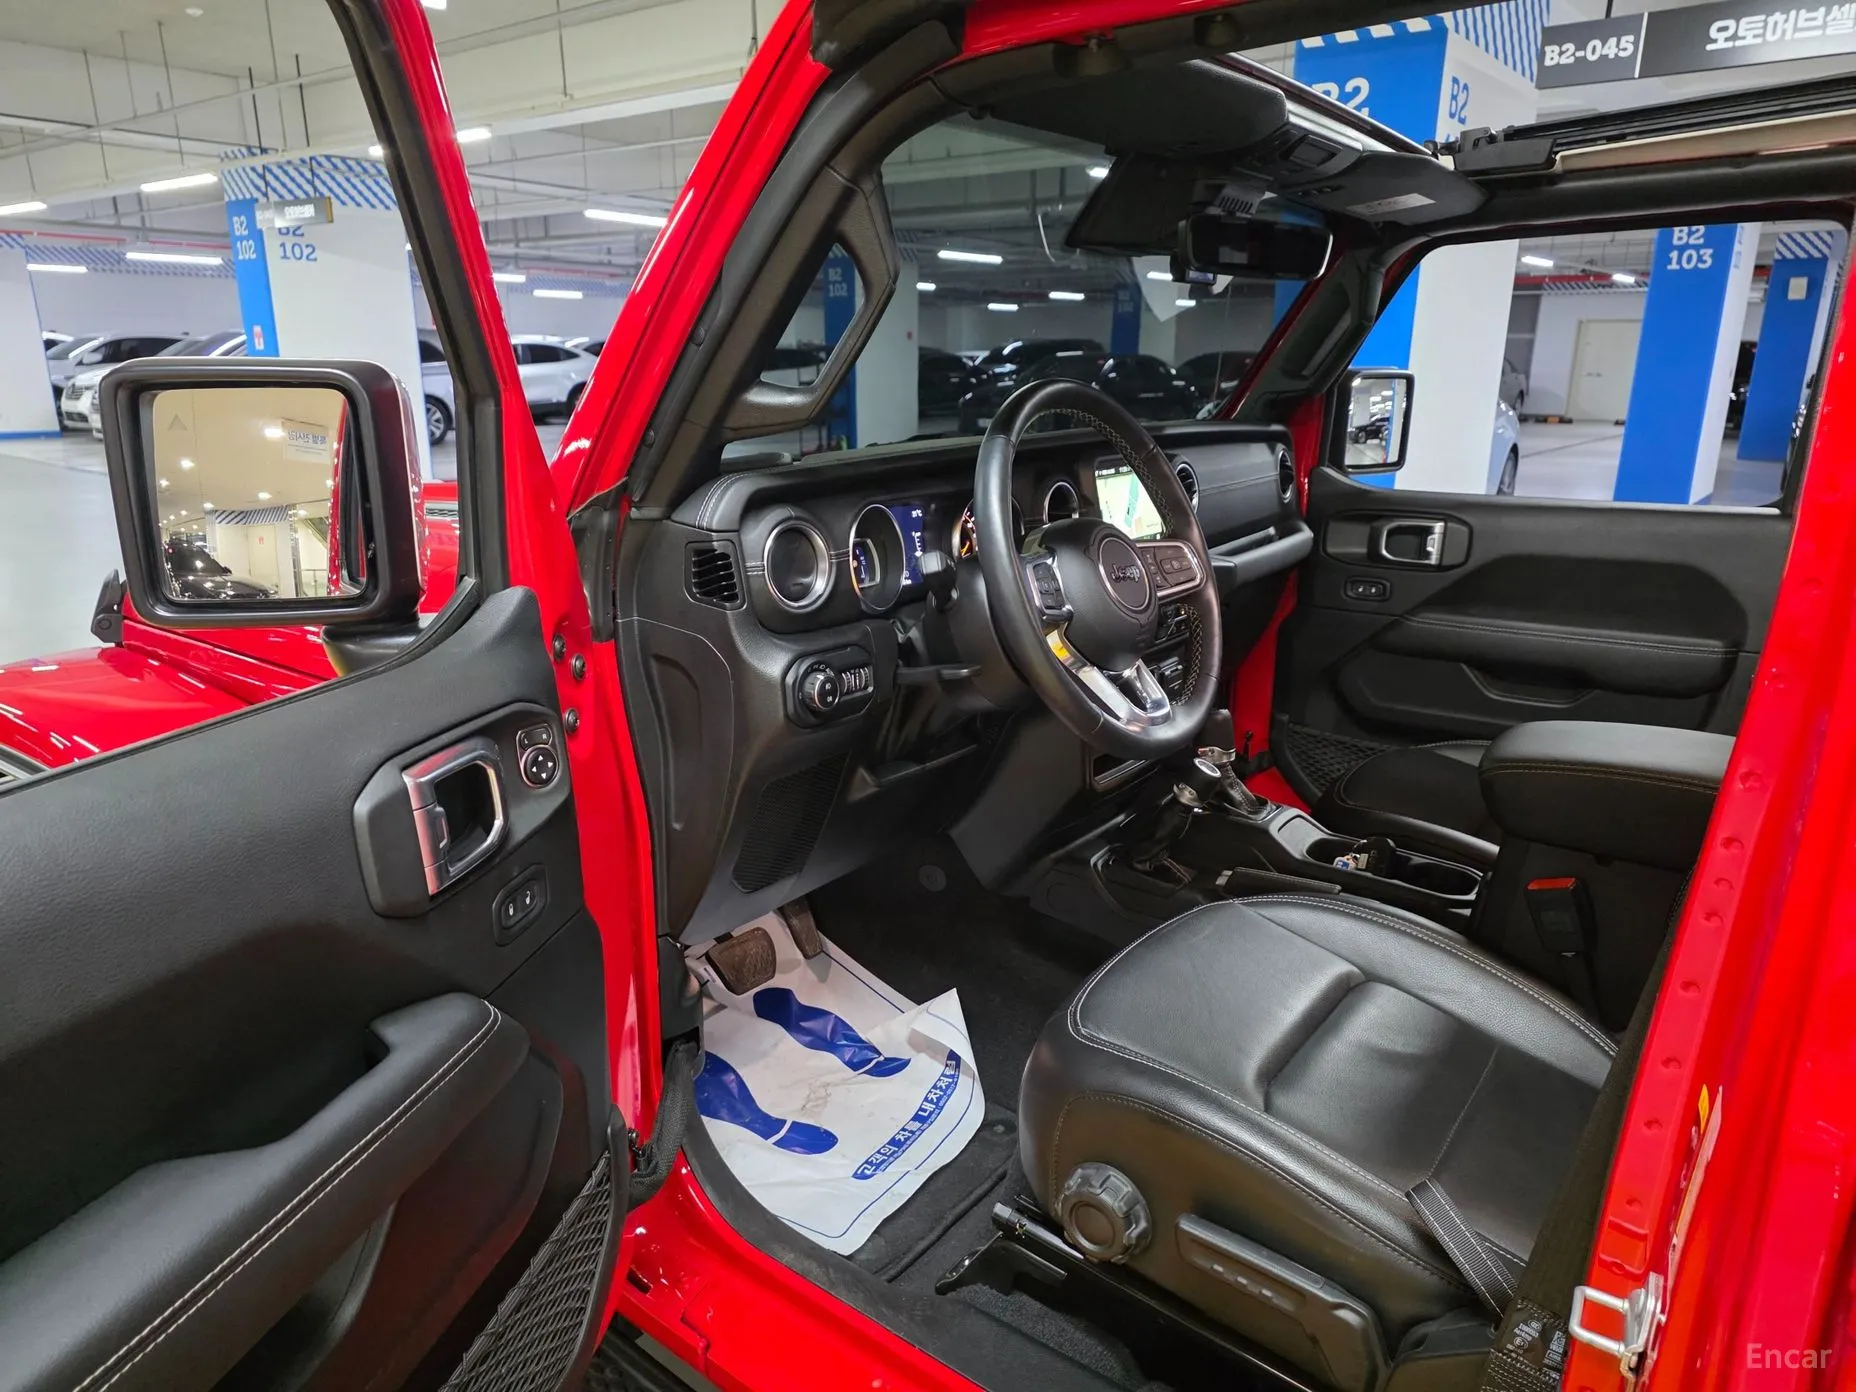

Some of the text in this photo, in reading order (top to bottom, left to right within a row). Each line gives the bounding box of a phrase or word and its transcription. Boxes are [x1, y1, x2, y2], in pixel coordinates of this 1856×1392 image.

[1544, 35, 1635, 66] B2-045
[1449, 76, 1470, 125] B2
[232, 215, 249, 236] B2
[1672, 226, 1706, 246] B2
[236, 239, 257, 260] 102
[279, 242, 318, 262] 102
[1666, 248, 1714, 270] 103
[828, 282, 849, 298] 102
[856, 1143, 899, 1175] 고객의
[895, 1120, 923, 1142] 차를
[918, 1060, 957, 1118] 내차처럼
